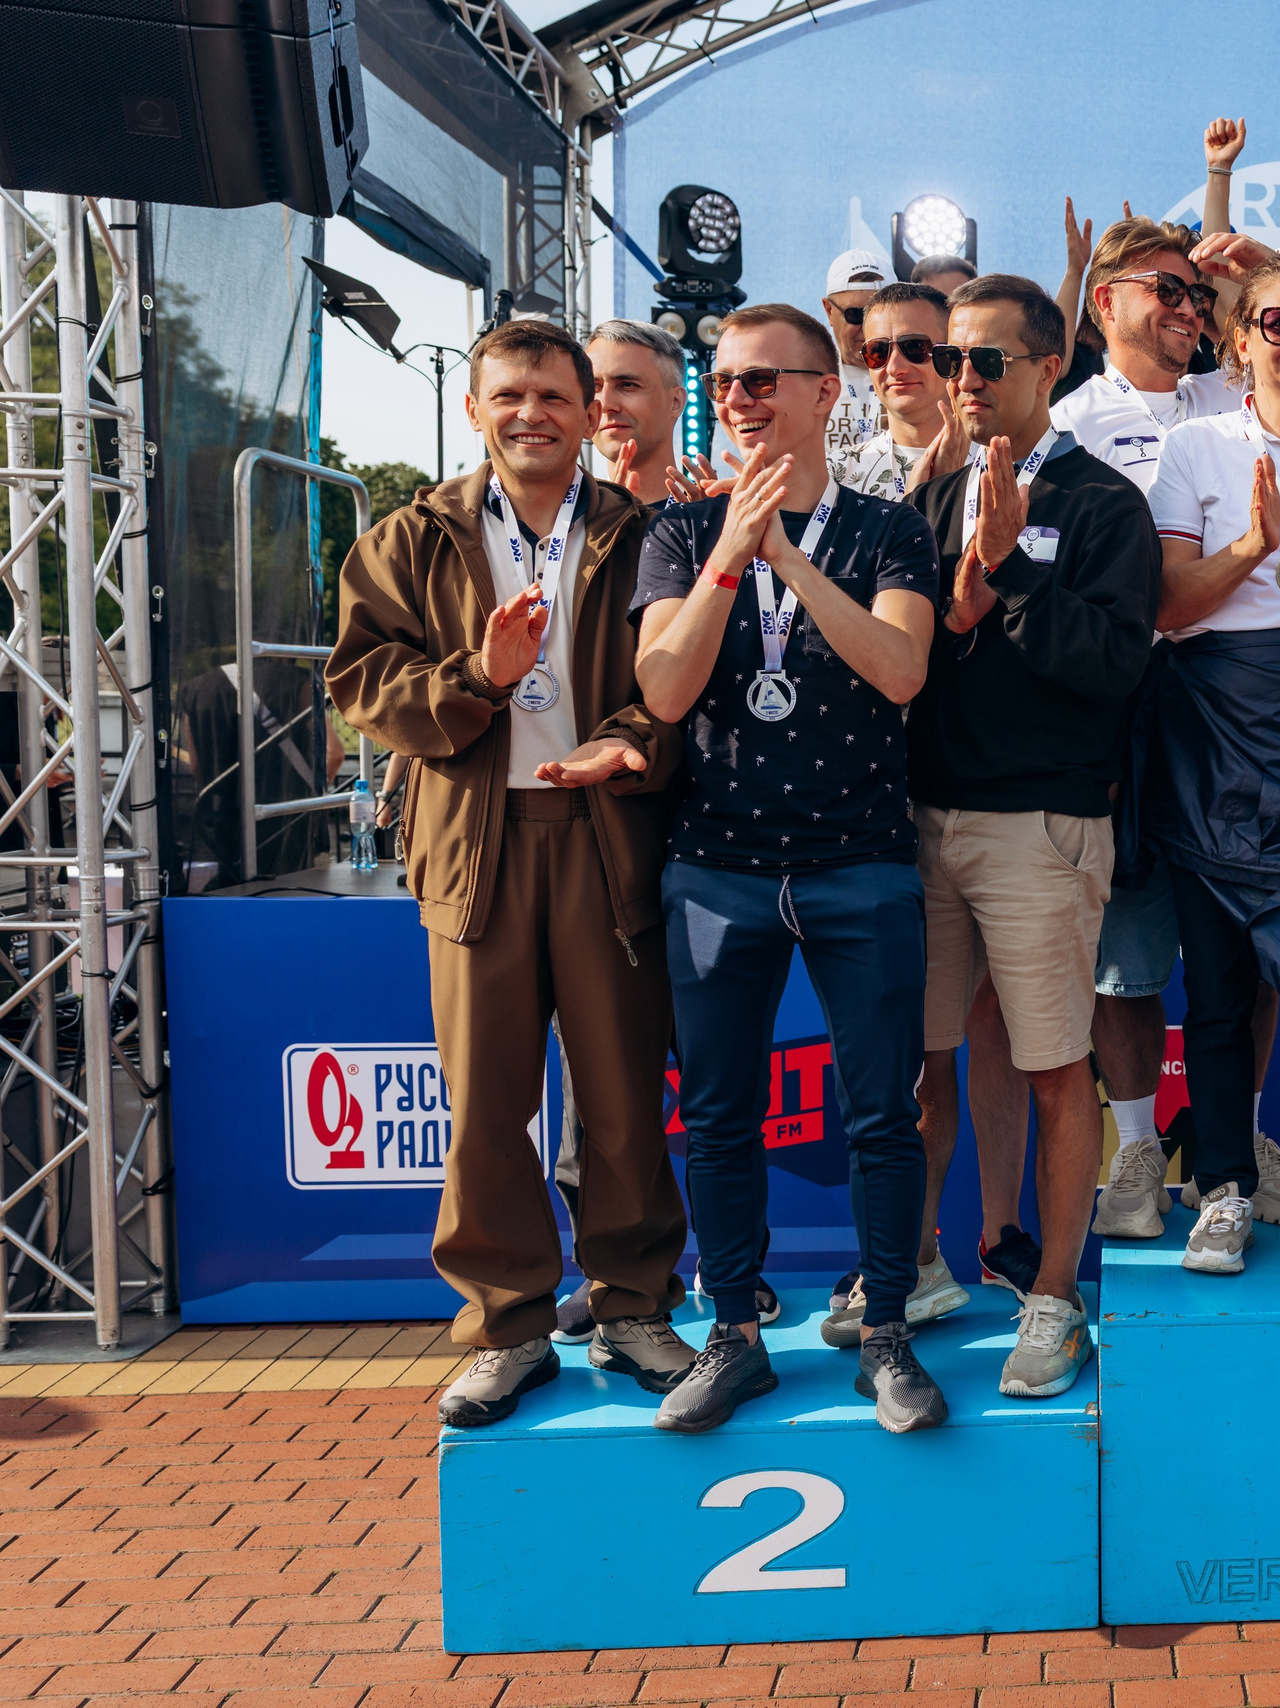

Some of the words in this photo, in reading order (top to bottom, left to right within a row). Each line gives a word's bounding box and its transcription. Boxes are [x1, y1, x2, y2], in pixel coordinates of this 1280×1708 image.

[375, 1063, 452, 1112] РУСС
[377, 1120, 452, 1169] РАД
[776, 1121, 803, 1139] FM
[694, 1468, 848, 1595] 2
